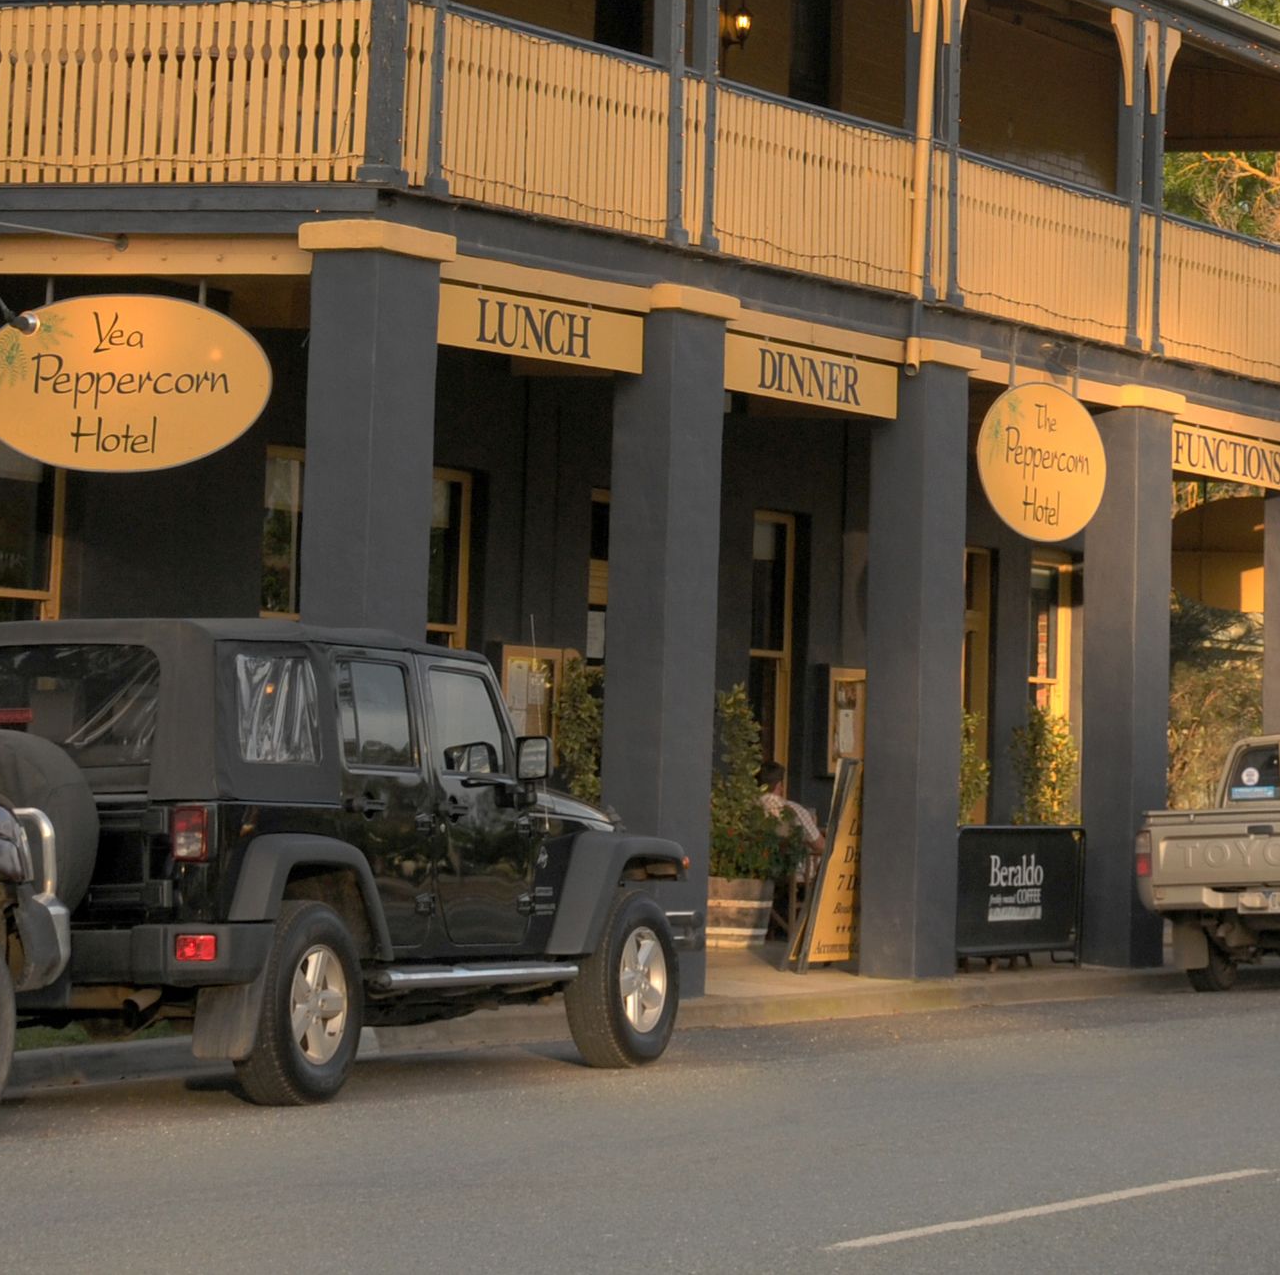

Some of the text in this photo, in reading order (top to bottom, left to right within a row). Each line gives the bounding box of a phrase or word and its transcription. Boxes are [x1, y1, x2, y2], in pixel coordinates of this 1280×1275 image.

[93, 311, 144, 353] Yea
[476, 298, 591, 359] LUNCH
[31, 353, 230, 410] Peppercorn
[758, 347, 861, 406] DINNER
[70, 416, 157, 454] Hotel
[1035, 403, 1057, 433] The
[1005, 425, 1090, 481] Peppercorn
[1022, 485, 1061, 526] Hotel
[988, 853, 1044, 887] Beraldo
